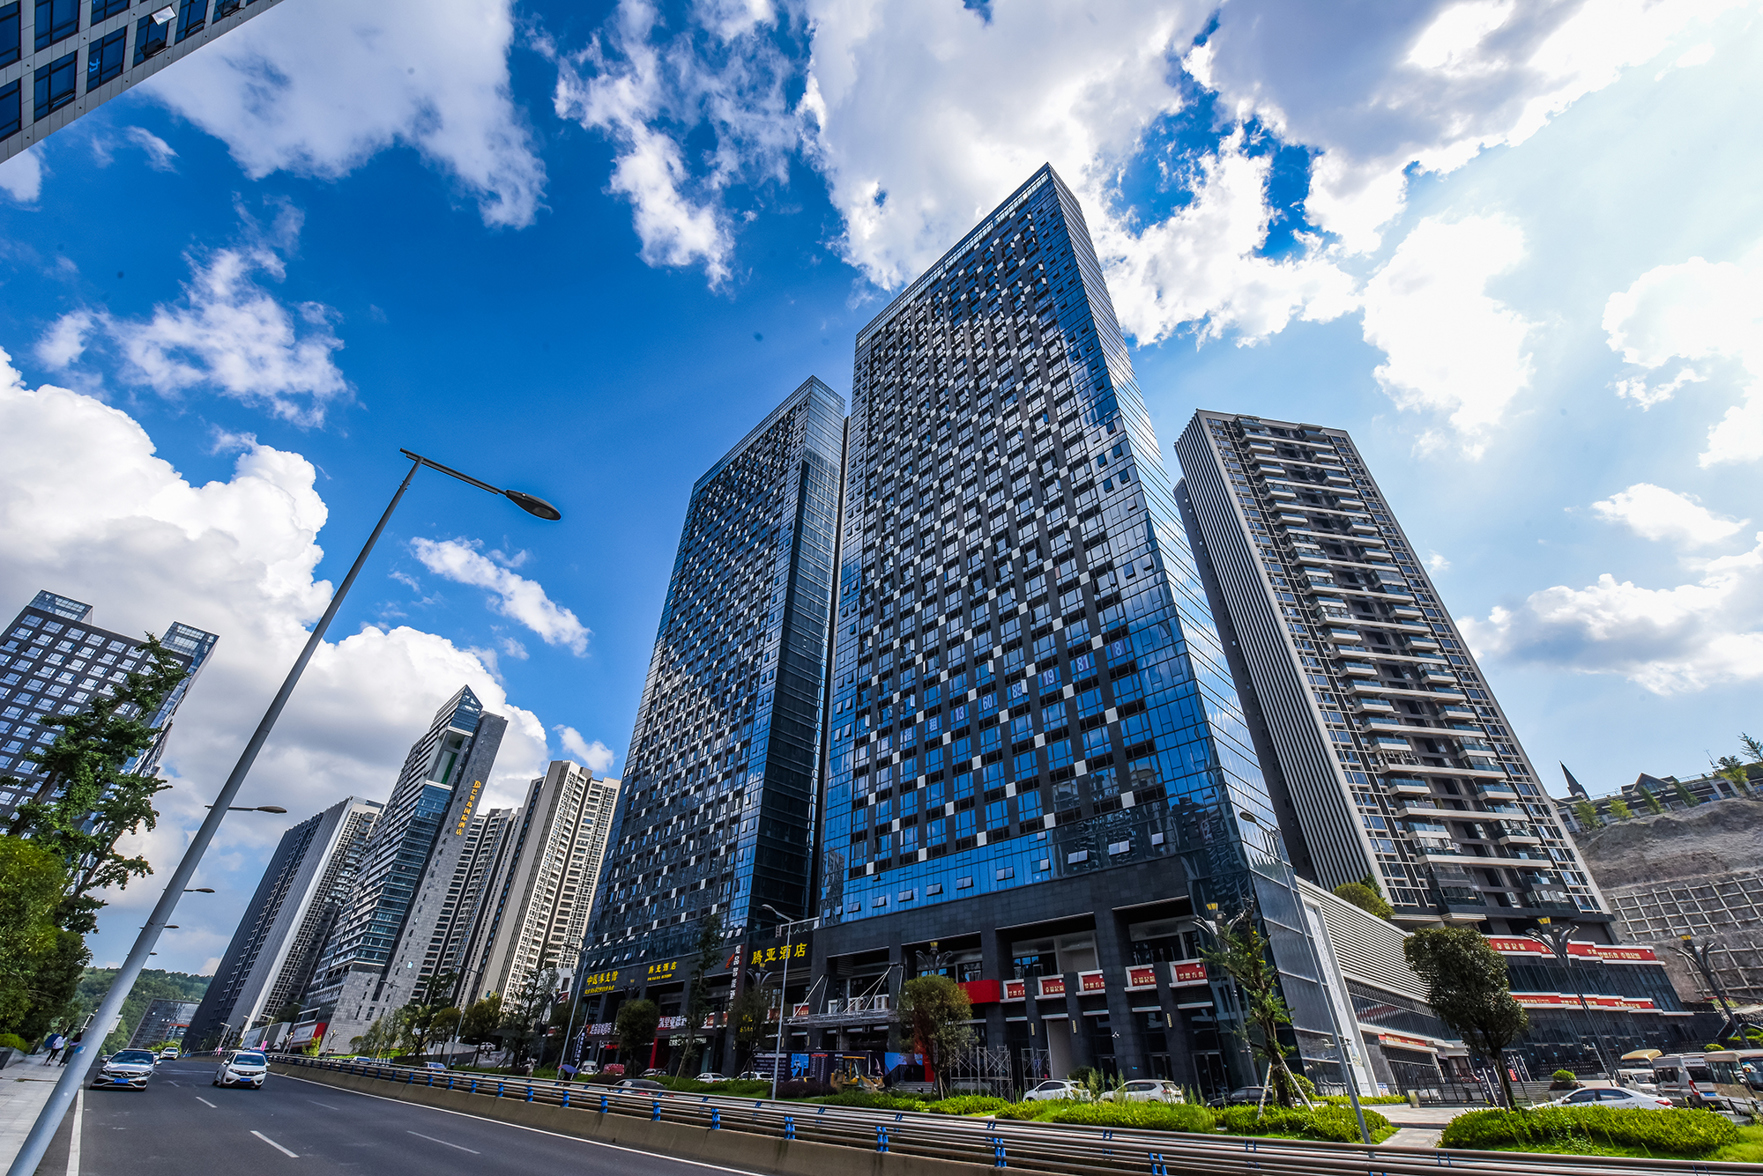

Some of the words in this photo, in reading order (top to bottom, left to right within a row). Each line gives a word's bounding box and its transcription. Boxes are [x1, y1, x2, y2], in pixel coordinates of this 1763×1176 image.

[955, 706, 965, 721] 13
[982, 694, 993, 710] 60
[1042, 669, 1055, 686] 19
[1076, 654, 1089, 672] 81
[1115, 641, 1122, 656] 8
[751, 942, 808, 965] 腾亚酒店
